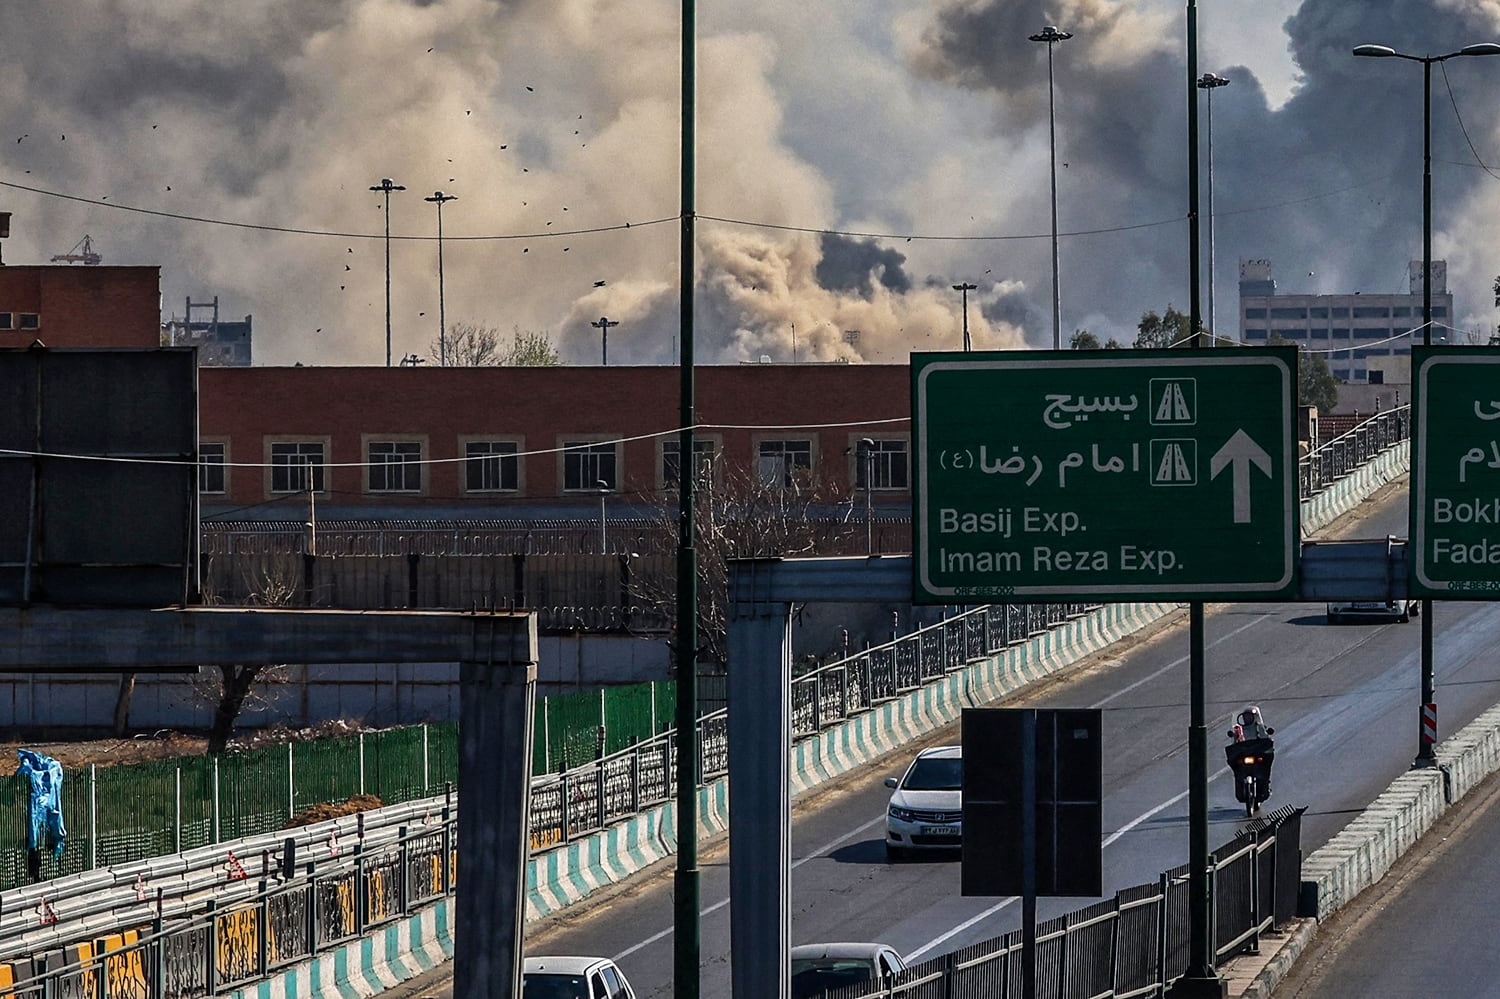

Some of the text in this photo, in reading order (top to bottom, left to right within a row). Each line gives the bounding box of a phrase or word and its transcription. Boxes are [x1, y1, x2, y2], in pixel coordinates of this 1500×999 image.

[1044, 395, 1137, 429] بسیج
[1059, 443, 1139, 487] امام
[941, 508, 1086, 538] Basij Exp.
[941, 546, 1183, 574] Imam Reza Exp.
